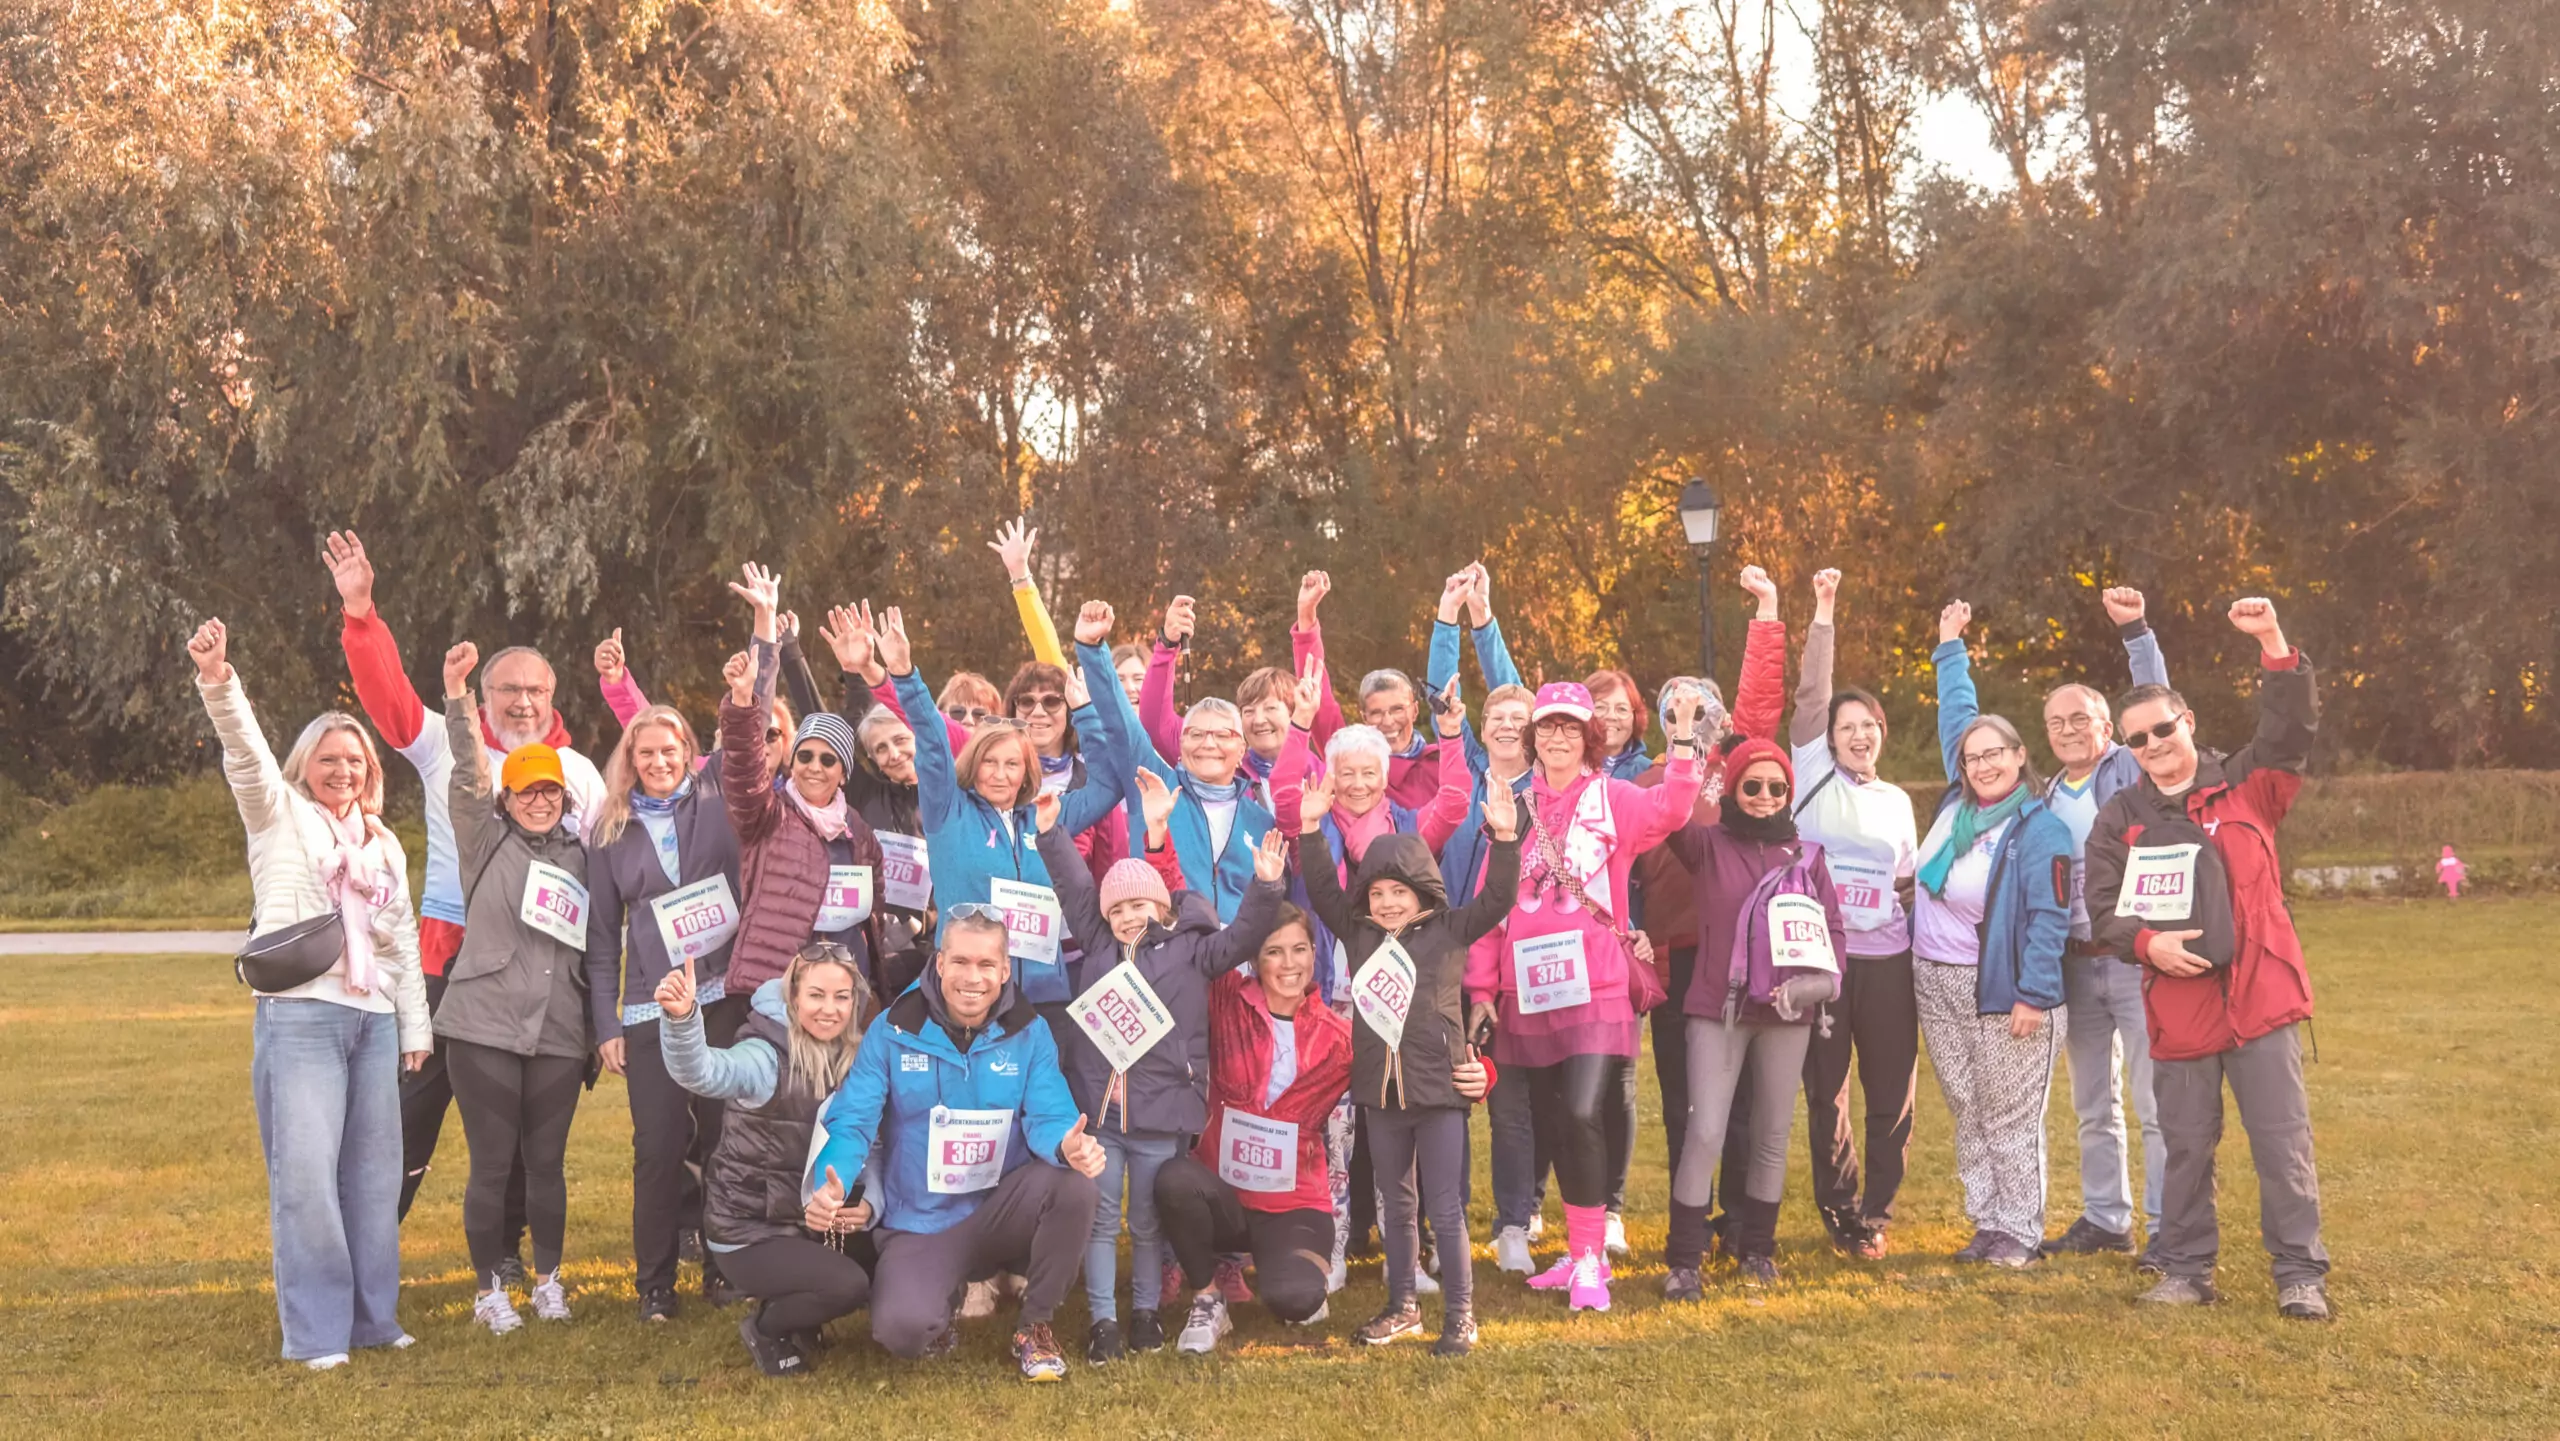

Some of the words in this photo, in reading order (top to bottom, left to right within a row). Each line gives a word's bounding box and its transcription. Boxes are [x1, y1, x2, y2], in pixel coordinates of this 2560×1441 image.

[883, 860, 914, 882] 376
[2141, 873, 2181, 894] 1644
[545, 891, 574, 920] 367
[1844, 886, 1872, 906] 377
[674, 905, 723, 937] 1069
[1010, 910, 1041, 933] 758
[1786, 921, 1823, 941] 1645
[1536, 962, 1567, 984] 374
[1098, 990, 1145, 1044] 3033
[951, 1141, 990, 1164] 369
[1238, 1142, 1275, 1168] 368
